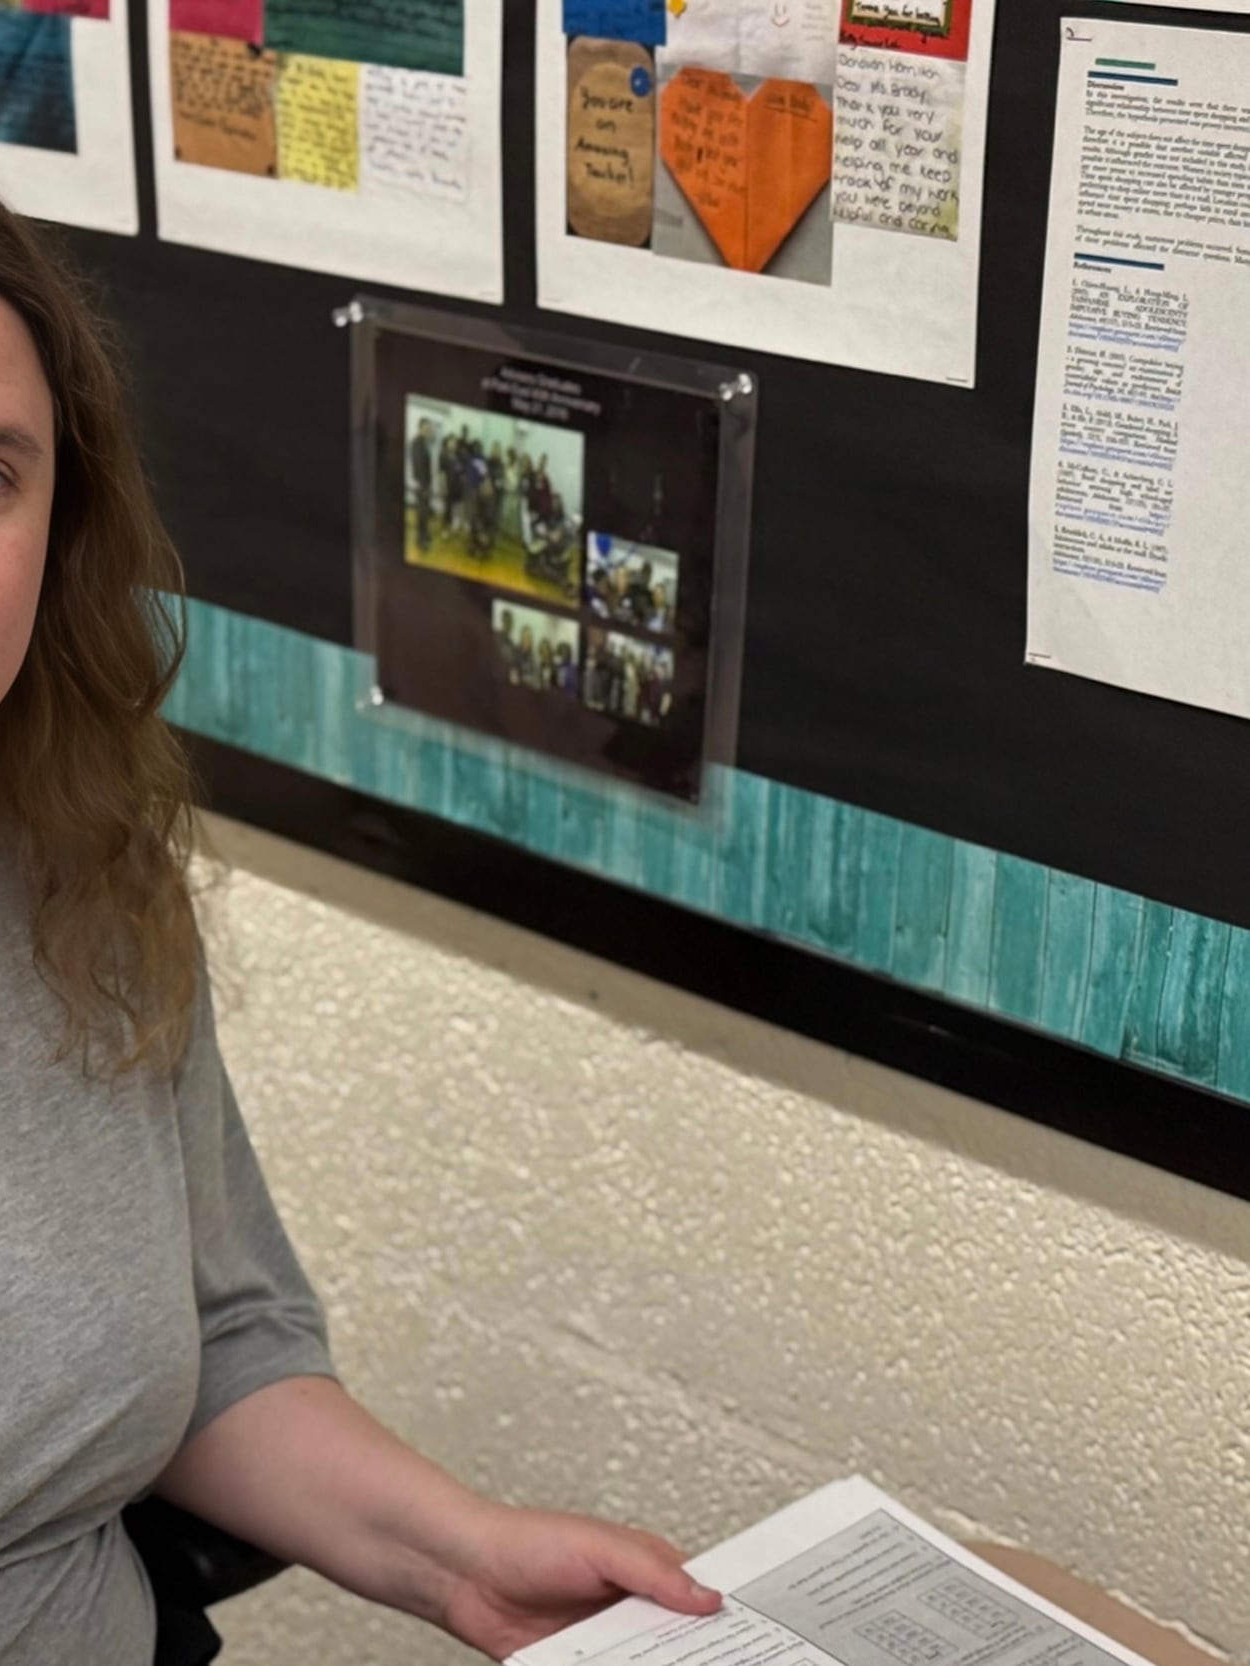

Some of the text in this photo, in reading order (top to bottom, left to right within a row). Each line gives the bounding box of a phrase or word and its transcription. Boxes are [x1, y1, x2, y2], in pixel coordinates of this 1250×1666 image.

[836, 95, 875, 114] Thank
[878, 104, 900, 118] you
[836, 115, 943, 142] much for your
[932, 148, 959, 164] and
[890, 162, 912, 175] me
